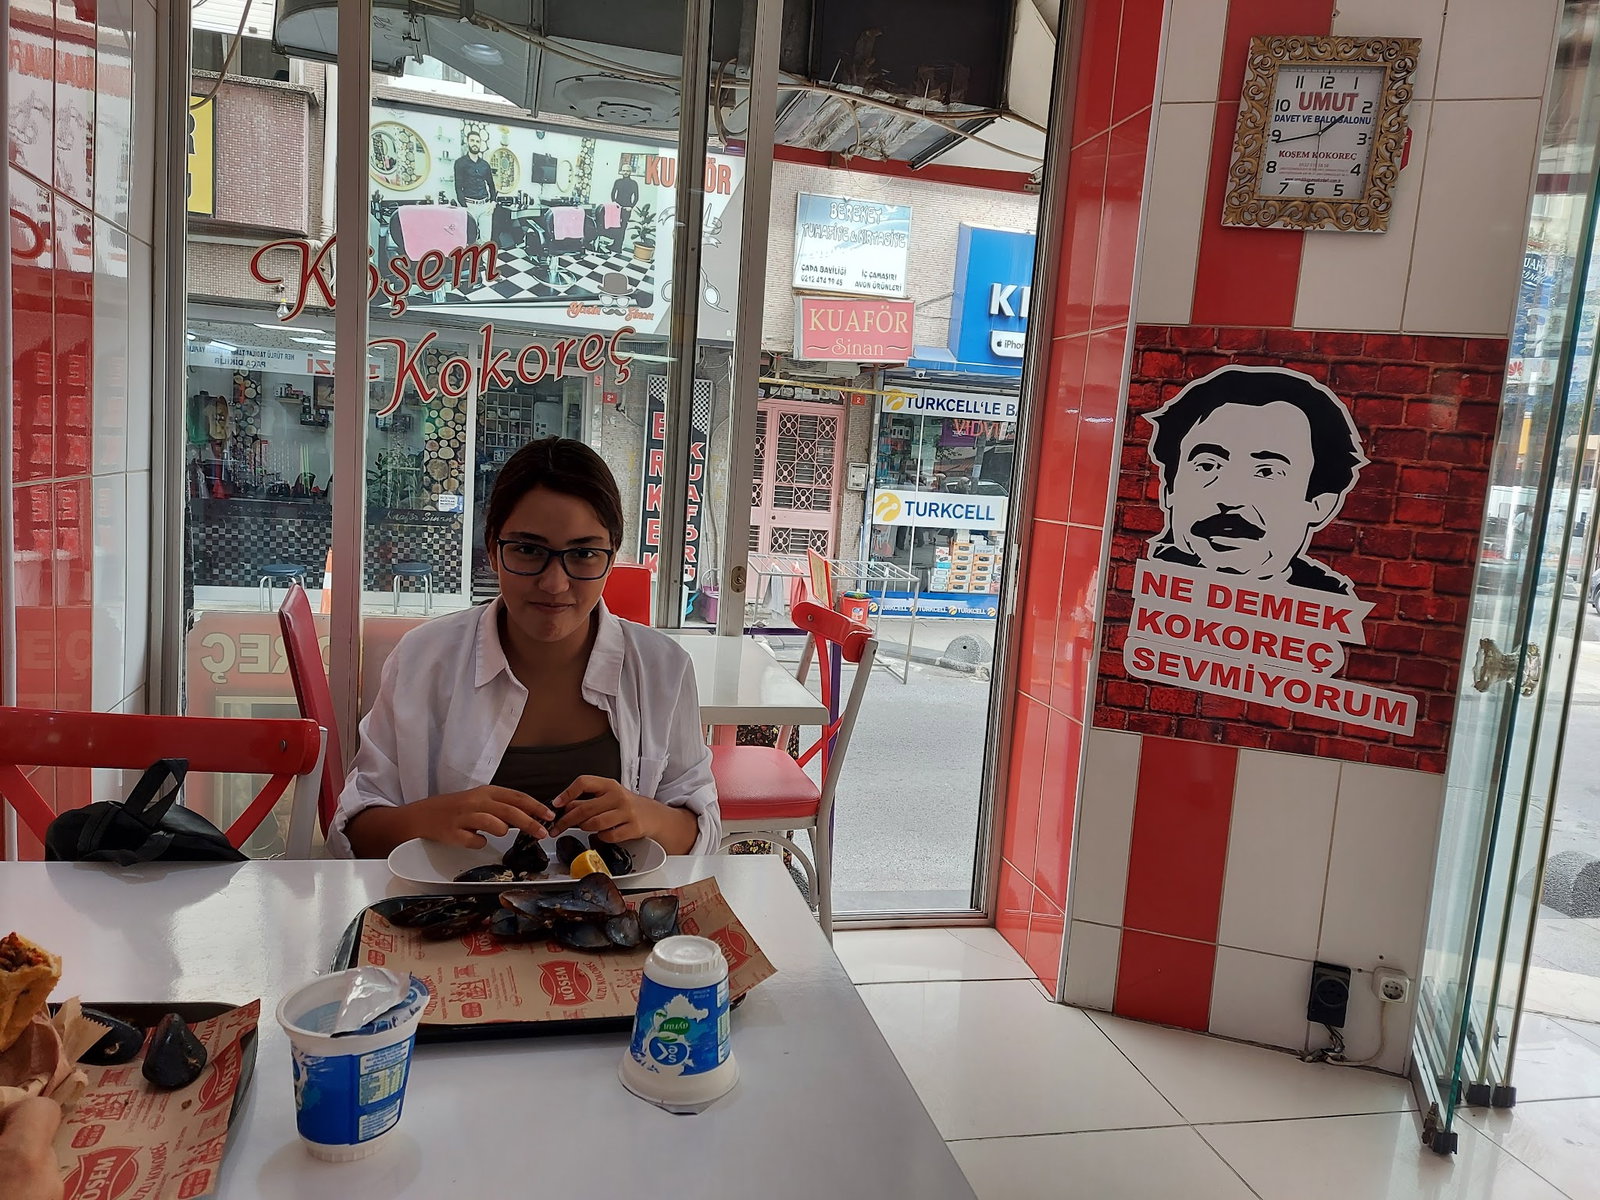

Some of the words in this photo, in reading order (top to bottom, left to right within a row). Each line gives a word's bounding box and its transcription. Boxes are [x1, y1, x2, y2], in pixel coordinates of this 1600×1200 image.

[1295, 75, 1304, 89] 11
[1320, 75, 1335, 89] 12
[1354, 77, 1359, 90] 1
[1275, 98, 1291, 112] 10
[1298, 91, 1359, 112] UMUT
[1361, 101, 1373, 114] 2
[1274, 114, 1301, 123] DAVET
[1302, 115, 1313, 123] VE
[1271, 129, 1282, 142] 9
[1356, 132, 1368, 146] 3
[1265, 160, 1278, 174] 8
[1349, 163, 1362, 177] 4
[645, 155, 732, 195] KUÖR
[1278, 182, 1289, 195] 7
[1304, 182, 1315, 196] 6
[1332, 183, 1345, 197] 5
[808, 303, 909, 335] KUAFÖR
[831, 337, 885, 358] Sinan
[366, 323, 637, 418] Kokoreç
[904, 500, 996, 521] TURKCELL
[1140, 571, 1194, 603] NE
[1206, 583, 1353, 635] DEMEK
[1136, 607, 1334, 673] KOKOREÇ
[1132, 647, 1409, 727] SEVMİYORUM
[554, 966, 576, 1000] KÖŞEM
[663, 1021, 689, 1031] ayran
[74, 1155, 118, 1200] ÖŞEM
